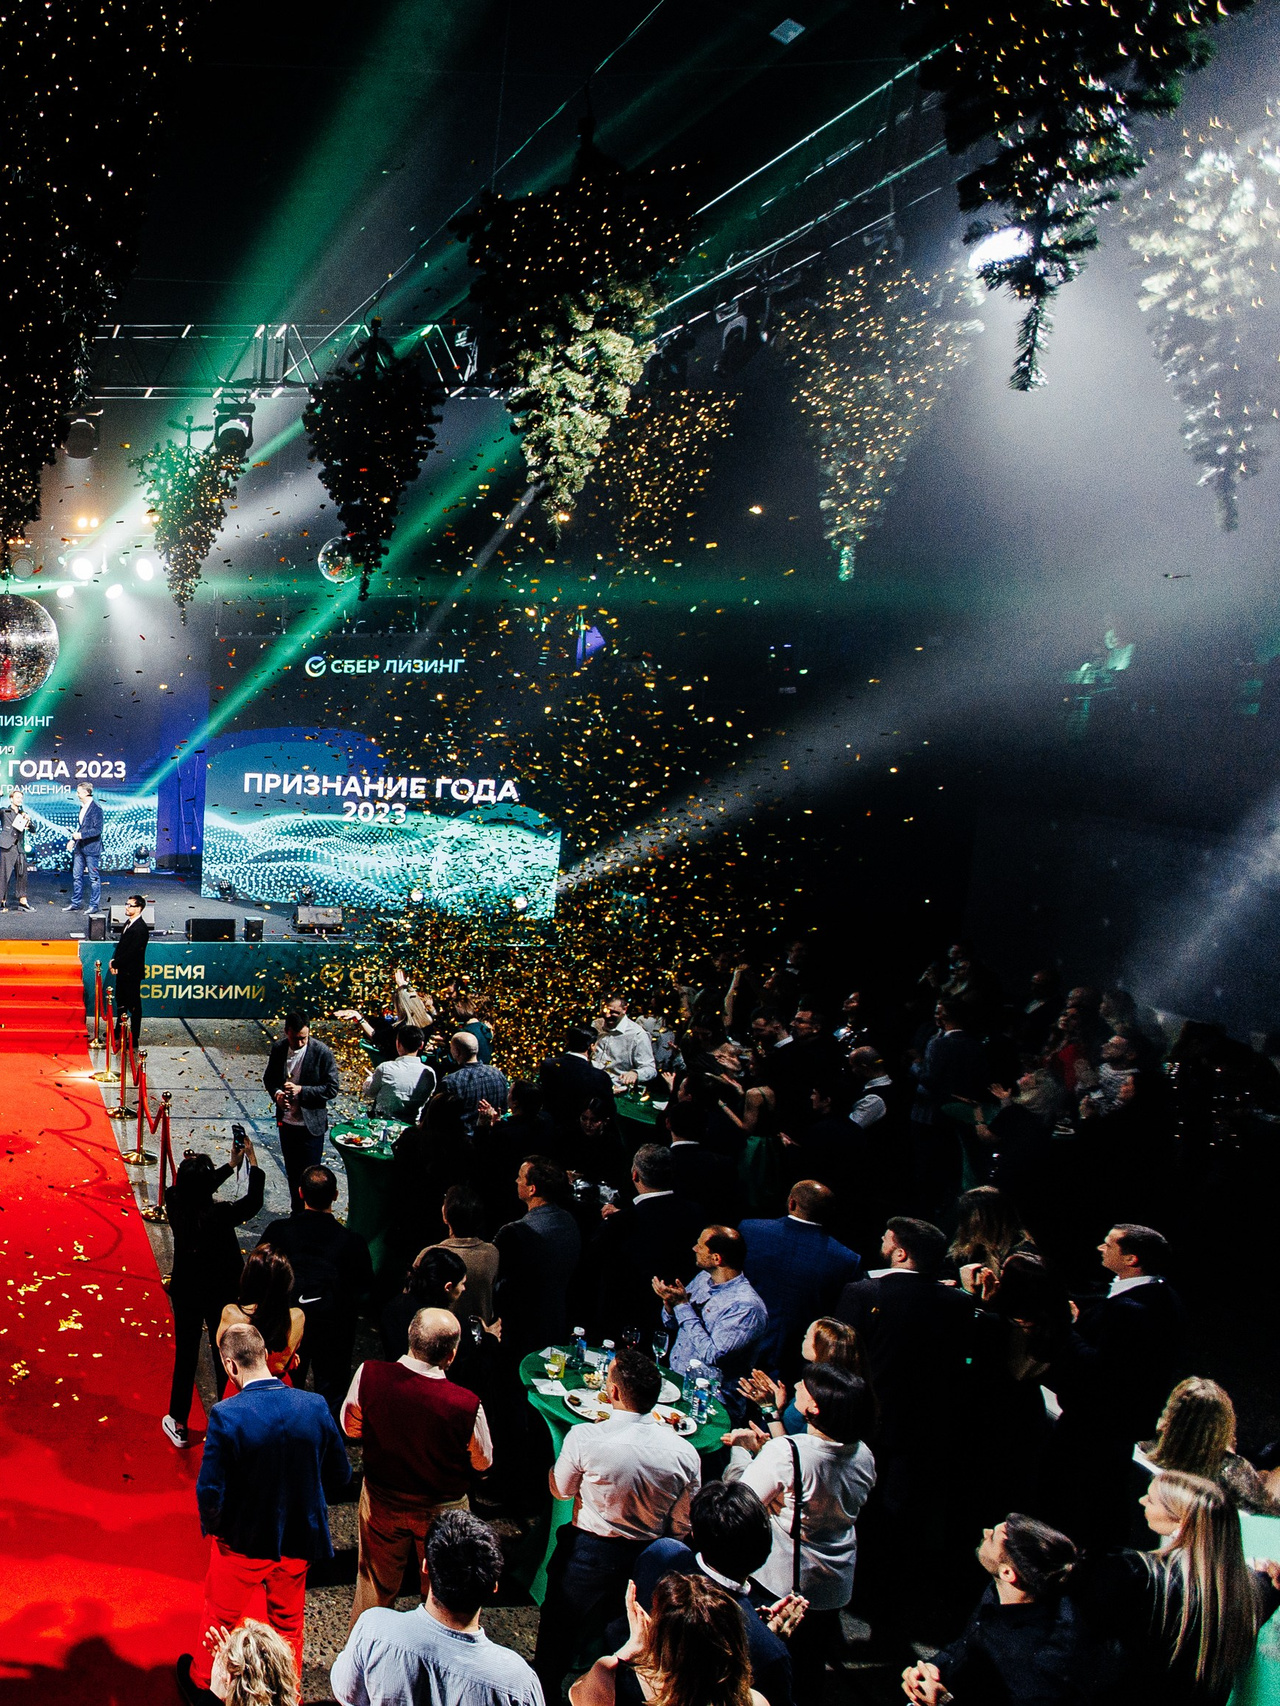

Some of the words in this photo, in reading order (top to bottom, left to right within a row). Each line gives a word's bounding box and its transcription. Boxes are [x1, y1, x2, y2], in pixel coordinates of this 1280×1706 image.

[330, 659, 380, 673] СБЕР
[383, 659, 465, 674] ЛИЗИНГ
[8, 760, 70, 780] ГОДА
[75, 760, 126, 778] 2023
[243, 772, 426, 799] ПРИЗНАНИЕ
[435, 776, 520, 804] ГОДА
[342, 801, 406, 824] 2023
